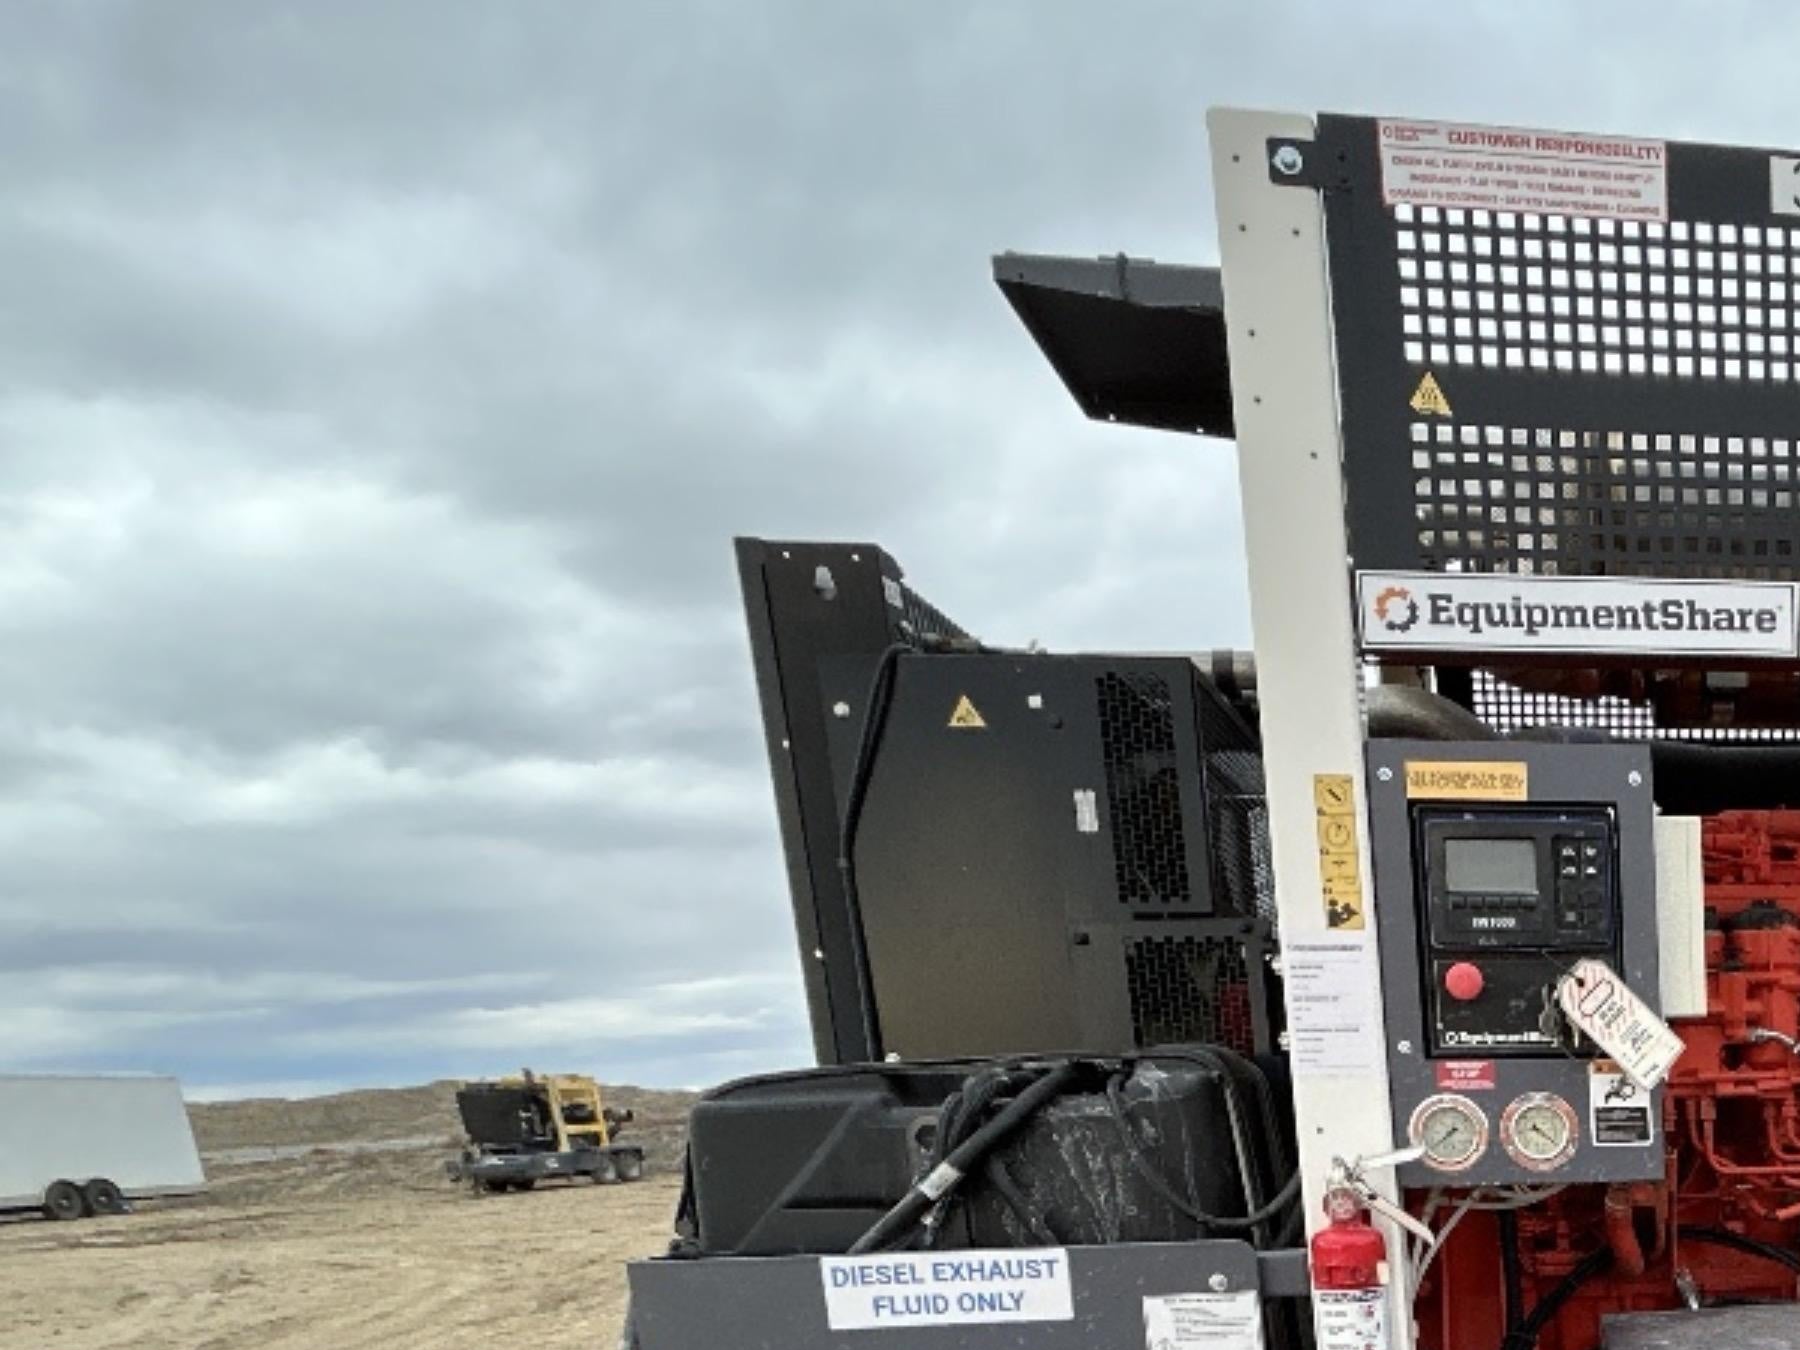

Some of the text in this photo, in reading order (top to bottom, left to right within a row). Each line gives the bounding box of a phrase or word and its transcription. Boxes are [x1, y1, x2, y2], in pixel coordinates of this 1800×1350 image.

[1448, 130, 1530, 149] CUSTOMER
[1536, 135, 1663, 161] RESPONSIBILITY
[1428, 593, 1778, 636] EquipmentShare
[830, 1258, 1060, 1288] DIESEL EXHAUST
[872, 1291, 1025, 1318] FLUID ONLY
